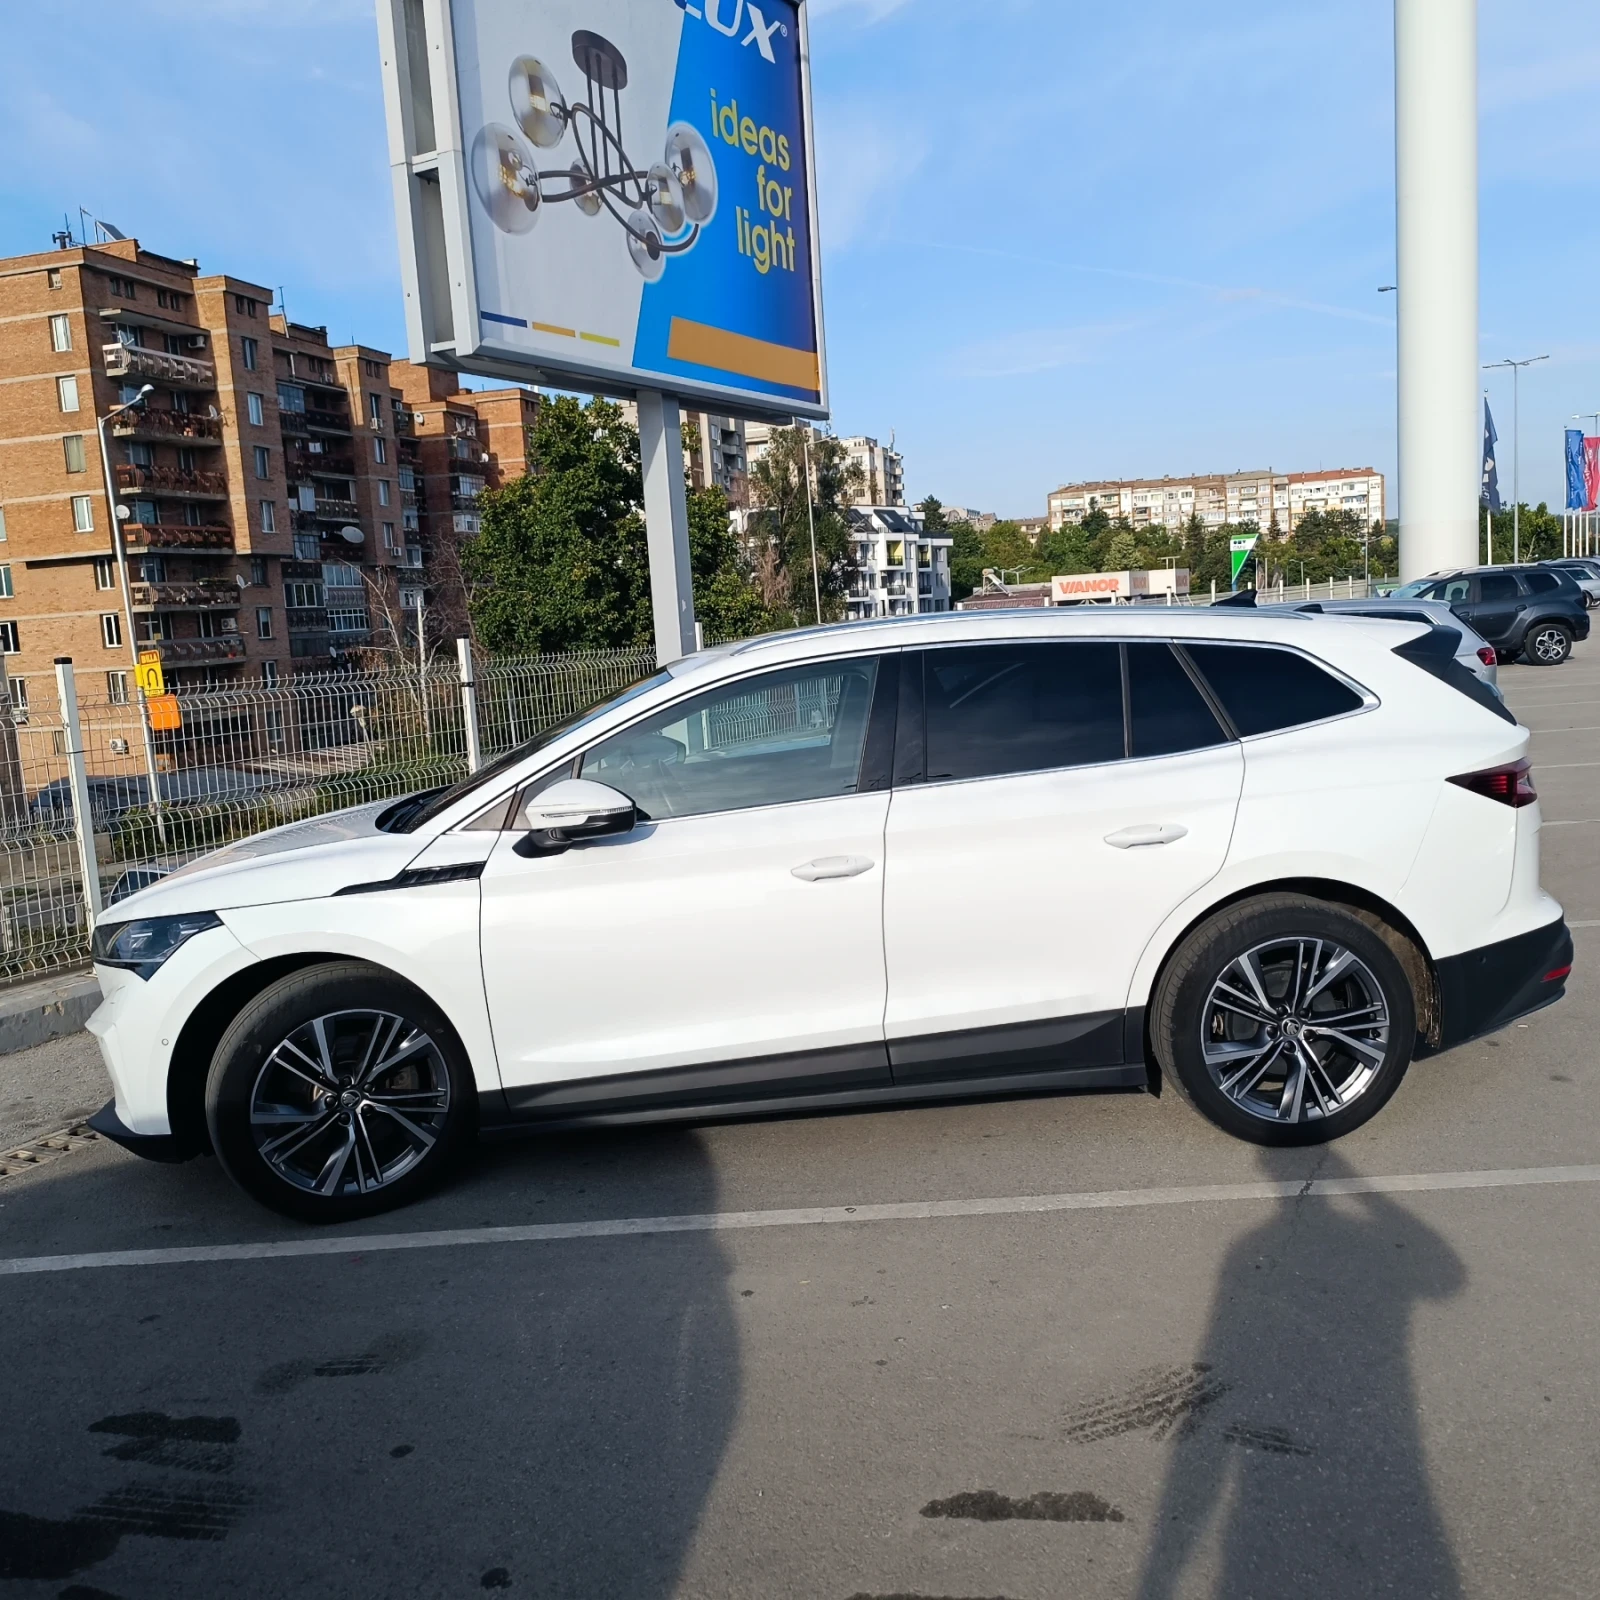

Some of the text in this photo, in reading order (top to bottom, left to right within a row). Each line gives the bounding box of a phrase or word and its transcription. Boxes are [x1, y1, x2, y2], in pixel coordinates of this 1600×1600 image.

[710, 88, 790, 171] ideas
[756, 165, 792, 221] for
[735, 205, 795, 274] light
[1059, 578, 1119, 594] VIANOR
